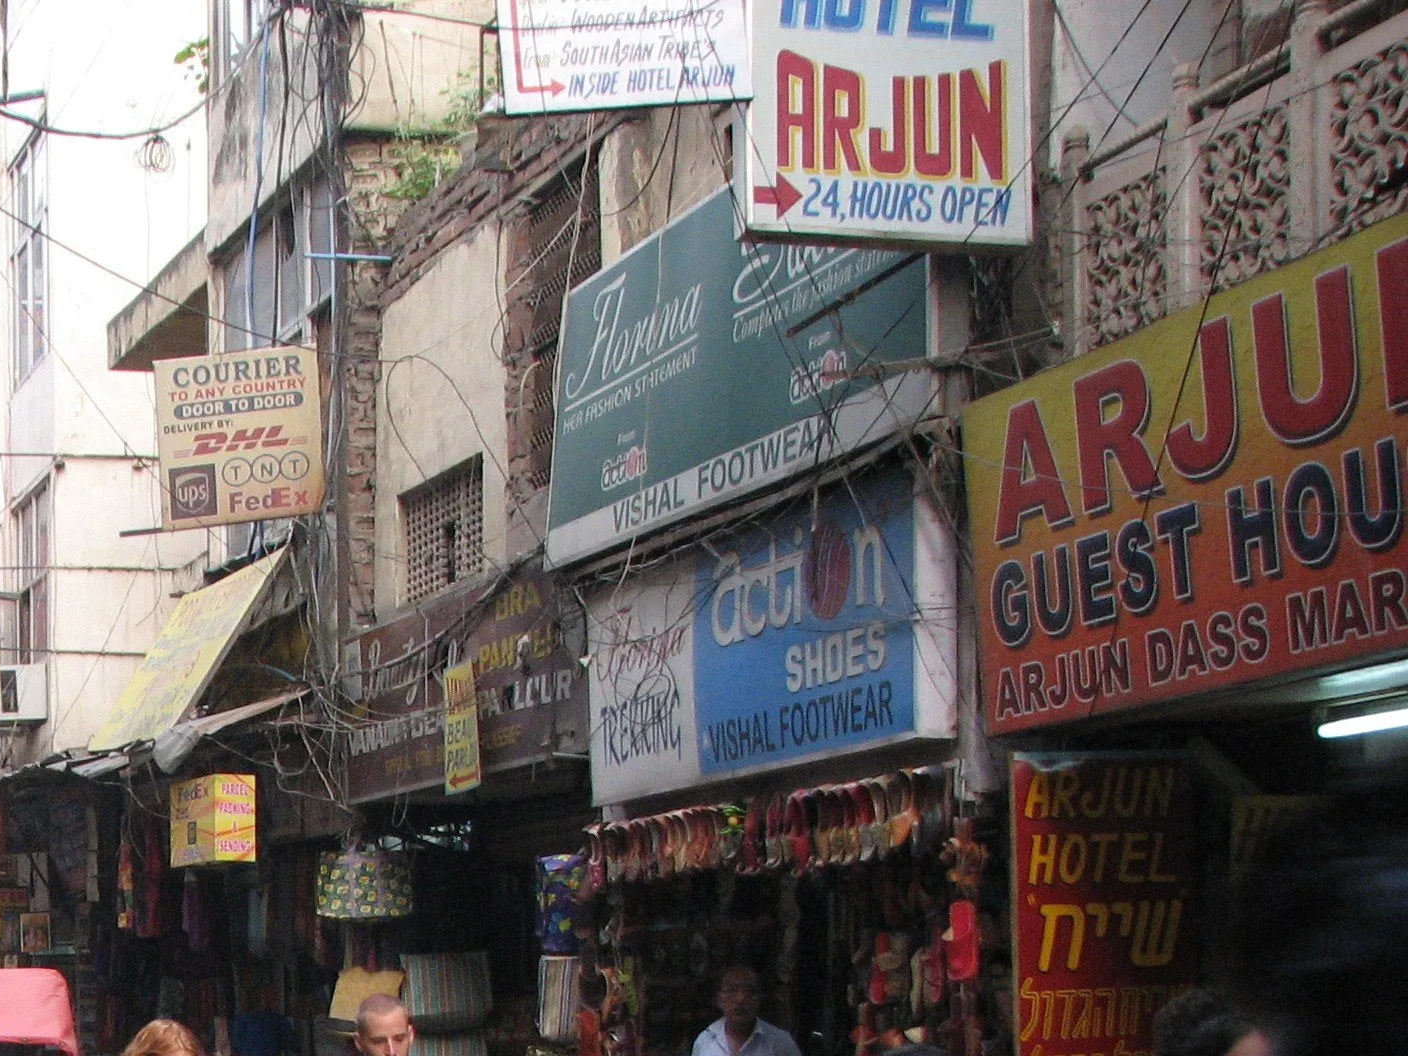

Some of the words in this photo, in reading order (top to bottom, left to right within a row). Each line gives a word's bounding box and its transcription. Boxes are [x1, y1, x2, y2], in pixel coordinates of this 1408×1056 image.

[567, 70, 621, 100] INSIDE
[627, 67, 676, 93] HOTEL
[681, 64, 737, 89] ARJUN
[776, 49, 1008, 187] ARJUN
[941, 186, 1013, 226] OPEN
[168, 391, 188, 403] TO
[195, 386, 227, 401] ANY
[232, 377, 307, 395] COUNTRY
[173, 355, 303, 389] COURIER
[585, 385, 632, 421] FASHION
[634, 346, 698, 398] STATEMENT
[163, 421, 213, 435] DELIVERY
[182, 401, 224, 418] DOOR
[229, 398, 249, 411] TO
[253, 394, 296, 409] DOOR
[192, 425, 291, 456] DHL
[228, 486, 309, 514] FedEx
[613, 482, 686, 534] VISHAL
[697, 413, 835, 500] FOOTWEAR
[993, 502, 1201, 650] GUEST
[1226, 436, 1408, 587] HOU
[711, 520, 887, 648] action
[784, 621, 889, 694] SHOES
[994, 638, 1133, 724] ARJUN
[1145, 603, 1271, 688] DASS
[1287, 566, 1408, 656] MAR
[708, 715, 777, 764] VISHAL
[779, 680, 893, 750] FOOTWEAR
[1024, 764, 1177, 820] ARJUN
[1028, 832, 1179, 887] HOTEL
